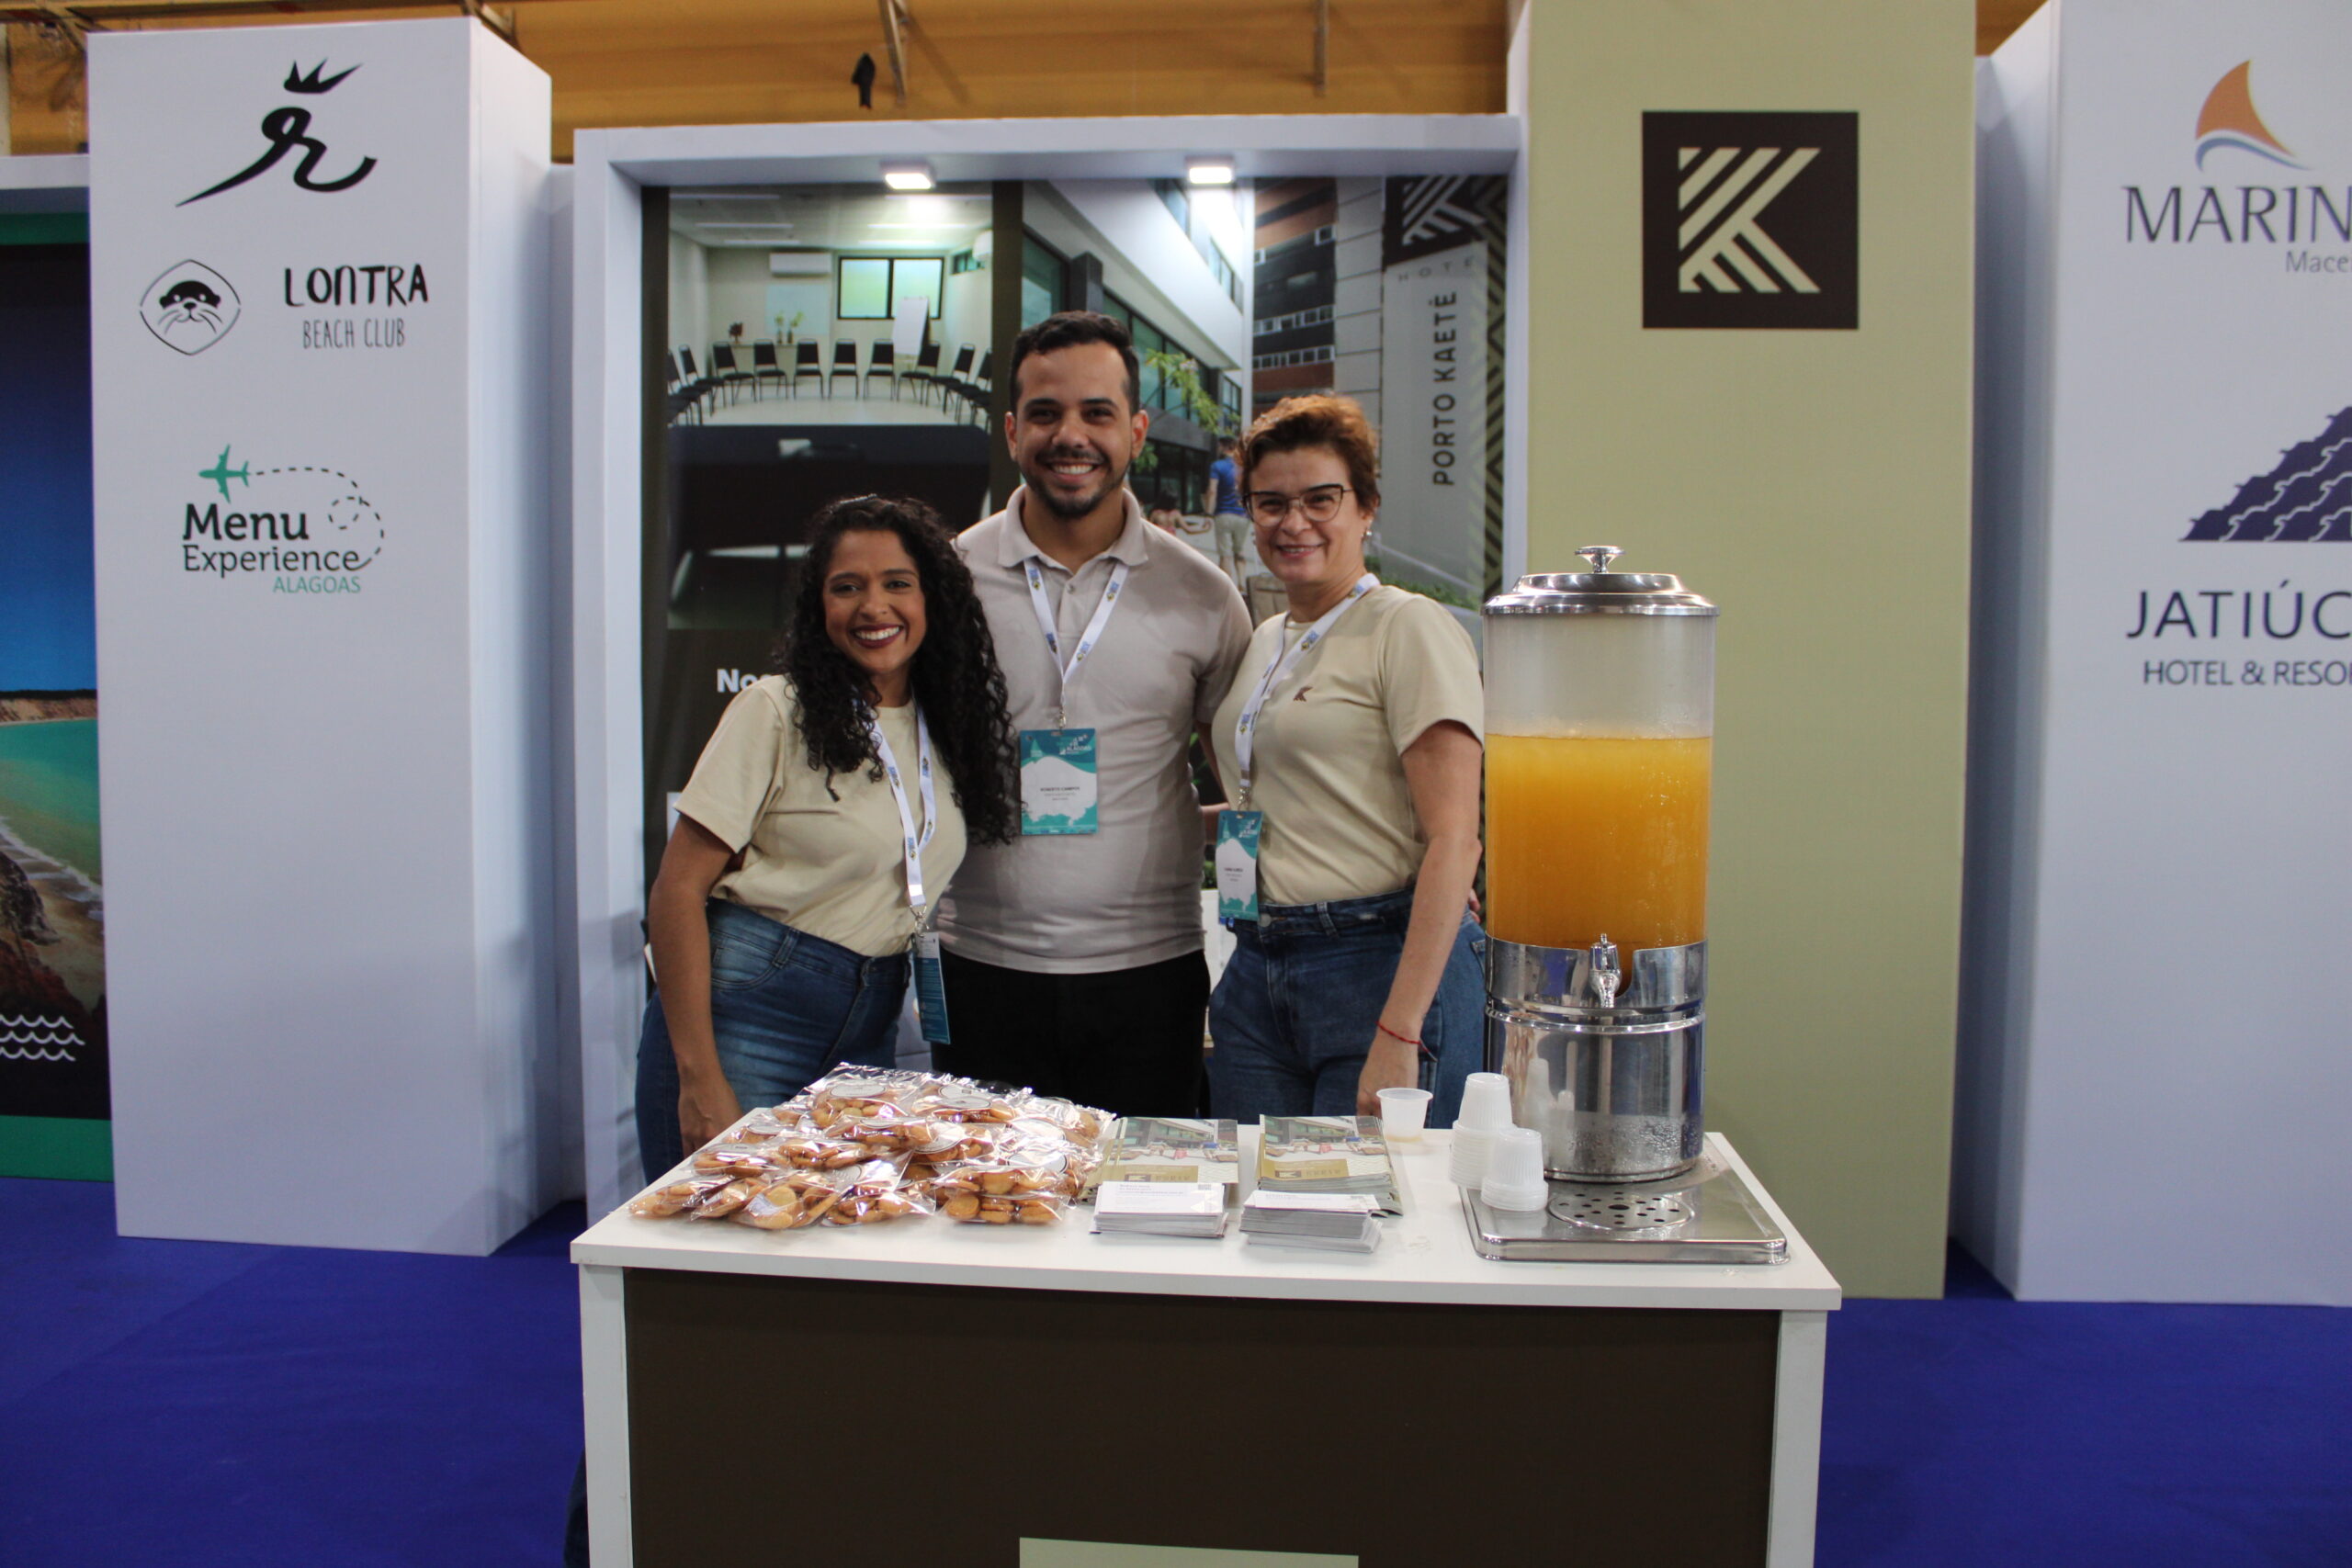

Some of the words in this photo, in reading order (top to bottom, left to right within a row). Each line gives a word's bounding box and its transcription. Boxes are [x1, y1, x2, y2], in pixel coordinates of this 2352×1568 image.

[2122, 186, 2352, 243] MARIN
[2286, 250, 2352, 274] Mace
[302, 319, 355, 349] BEACH
[364, 318, 405, 348] CLUB
[1429, 291, 1457, 382] KAETÉ
[1432, 393, 1456, 486] PORTO
[182, 502, 310, 541] Menu
[182, 546, 359, 579] Experience
[273, 575, 362, 594] ALAGOAS
[2126, 579, 2352, 639] JATIÚC
[2143, 660, 2233, 685] HOTEL
[2241, 660, 2266, 686] &
[2274, 660, 2352, 686] RESO
